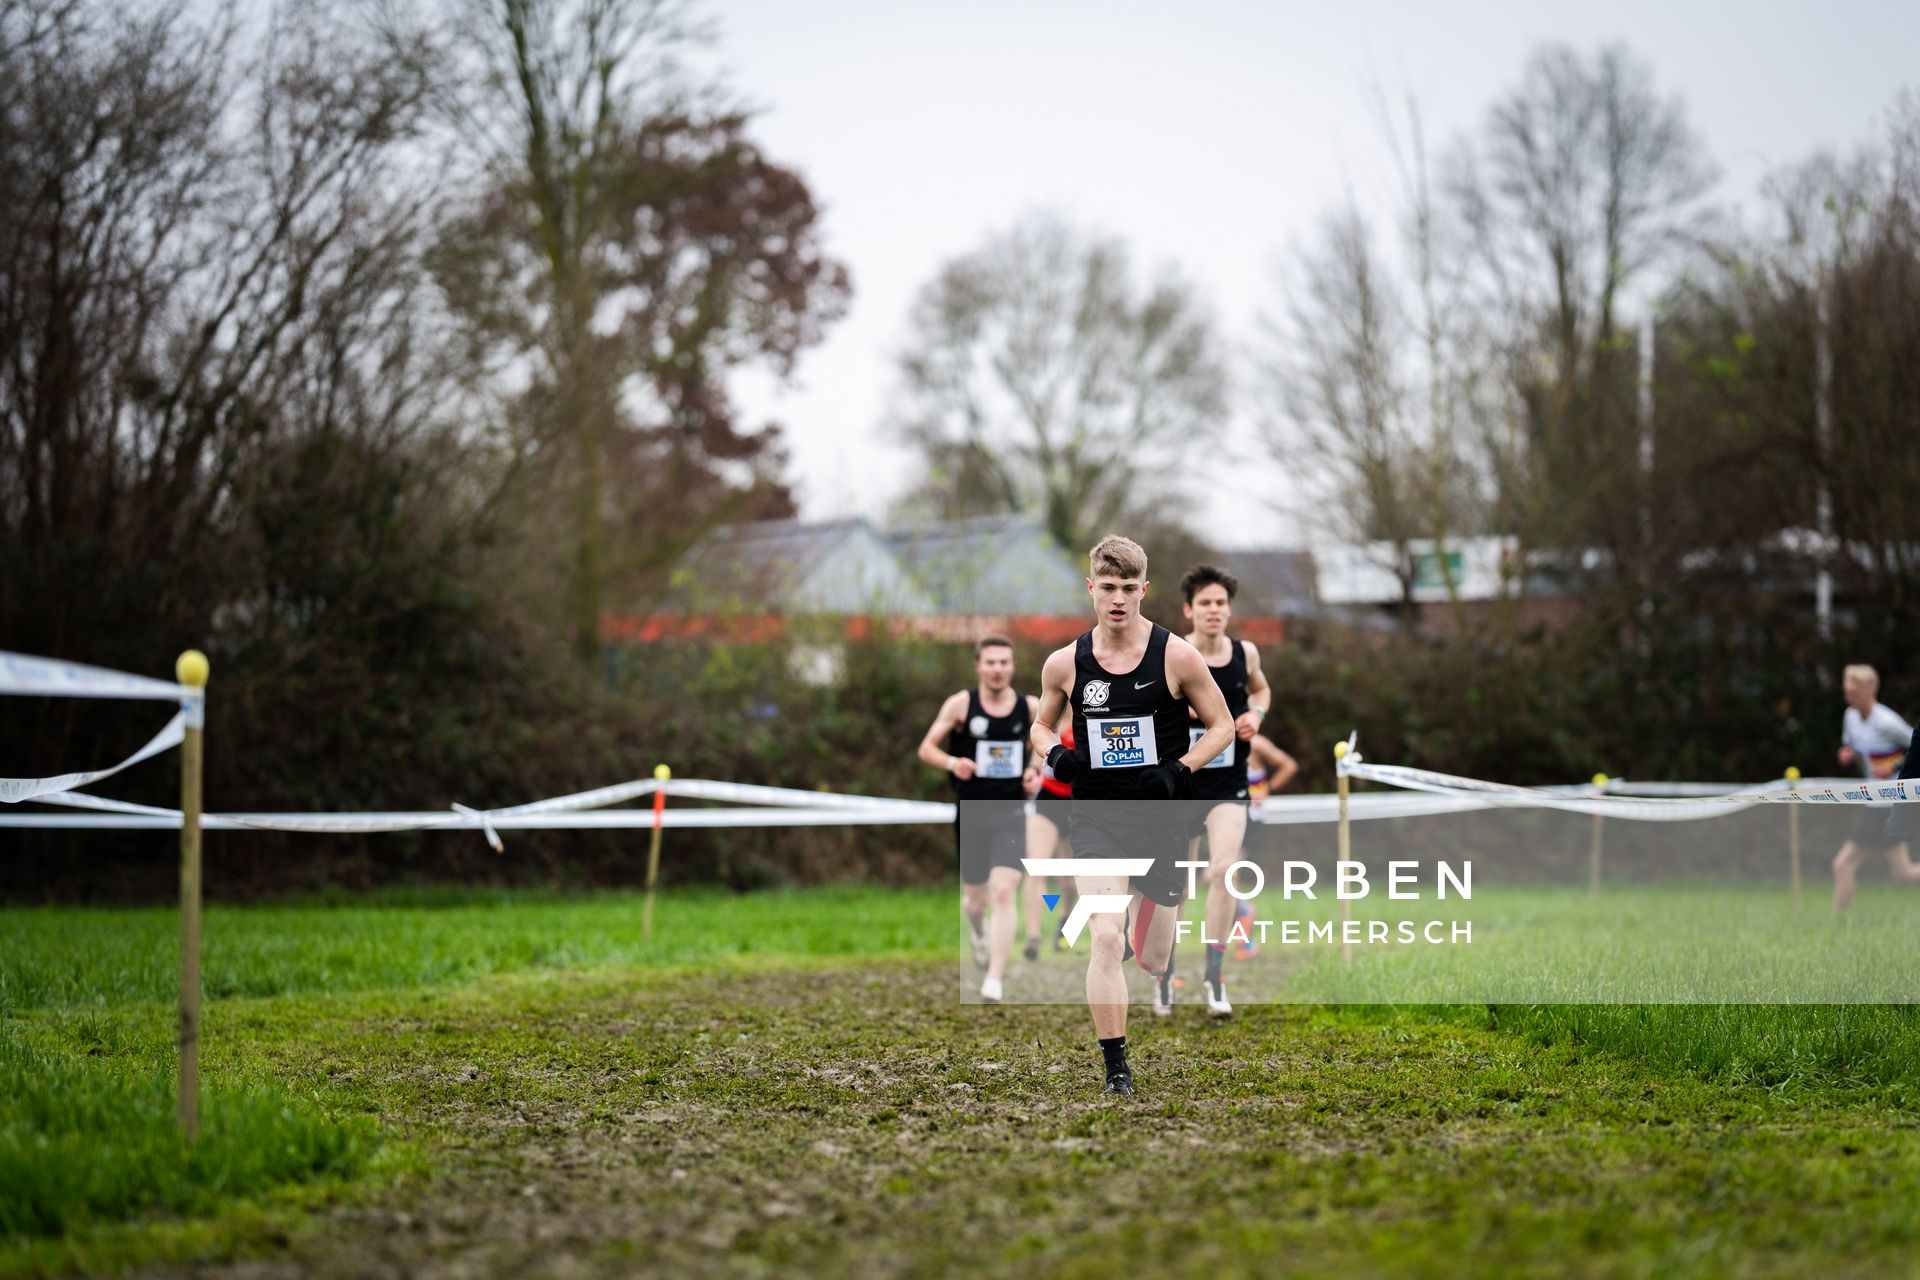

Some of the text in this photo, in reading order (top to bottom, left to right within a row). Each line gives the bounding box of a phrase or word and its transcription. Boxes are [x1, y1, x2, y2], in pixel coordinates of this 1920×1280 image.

[1083, 680, 1111, 707] 96
[1120, 726, 1137, 735] GLS
[1106, 738, 1136, 751] 301
[1119, 751, 1142, 760] PLAN
